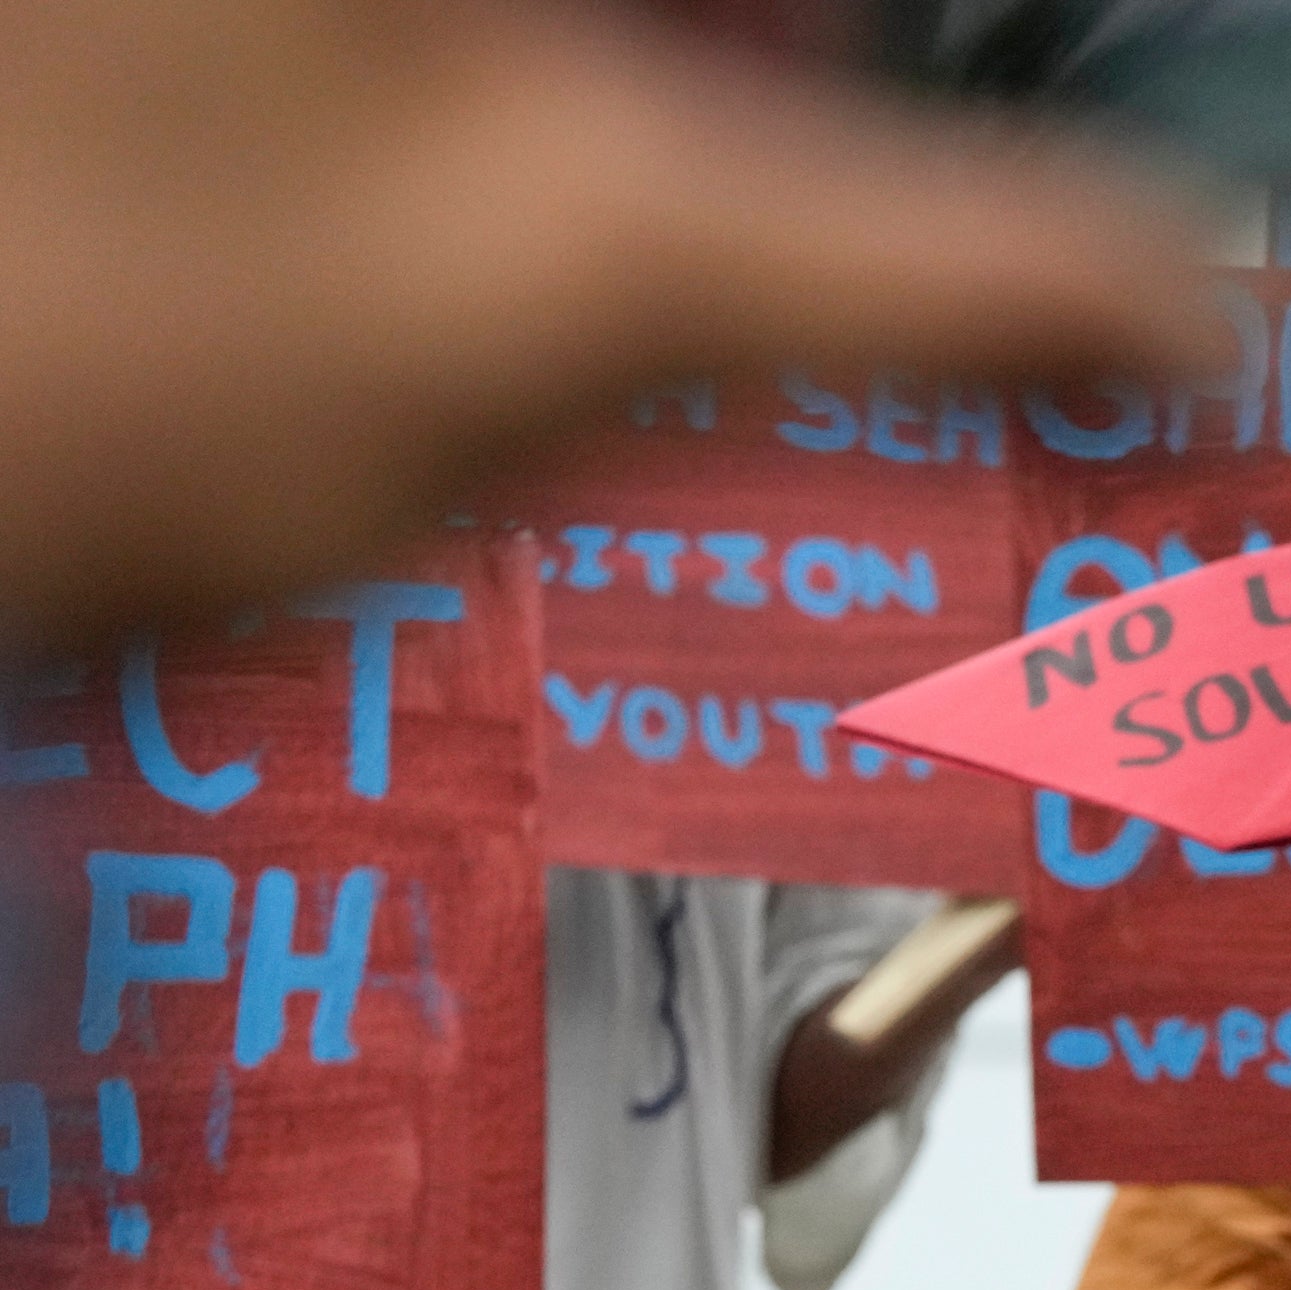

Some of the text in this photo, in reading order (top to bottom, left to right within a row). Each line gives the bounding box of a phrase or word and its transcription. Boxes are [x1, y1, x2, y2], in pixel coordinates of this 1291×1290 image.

[538, 524, 940, 619] ITION
[1022, 603, 1175, 710] NO
[78, 850, 388, 1070] PH
